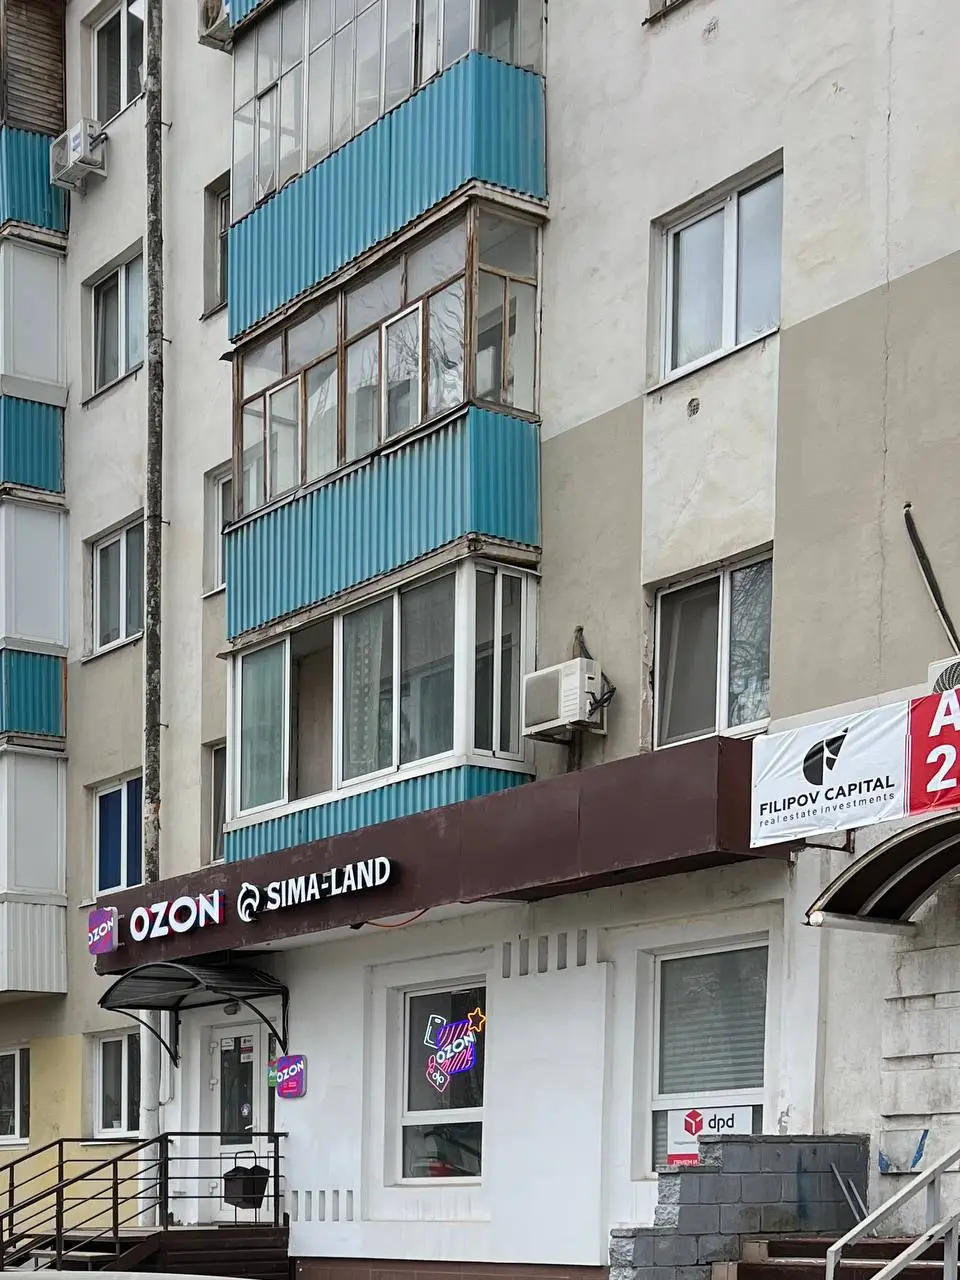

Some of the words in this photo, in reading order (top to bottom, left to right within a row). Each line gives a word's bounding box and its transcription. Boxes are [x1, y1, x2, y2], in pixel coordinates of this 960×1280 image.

[759, 790, 820, 816] FILIPOV
[824, 775, 895, 801] CAPITAL
[759, 815, 780, 828] real
[783, 806, 818, 821] estate
[820, 792, 895, 814] investments
[129, 889, 222, 942] OZON
[266, 856, 390, 910] SIMA-LAND
[89, 916, 114, 945] OZON
[436, 1030, 476, 1063] OZON
[276, 1060, 304, 1082] OZON
[708, 1113, 734, 1132] dpd
